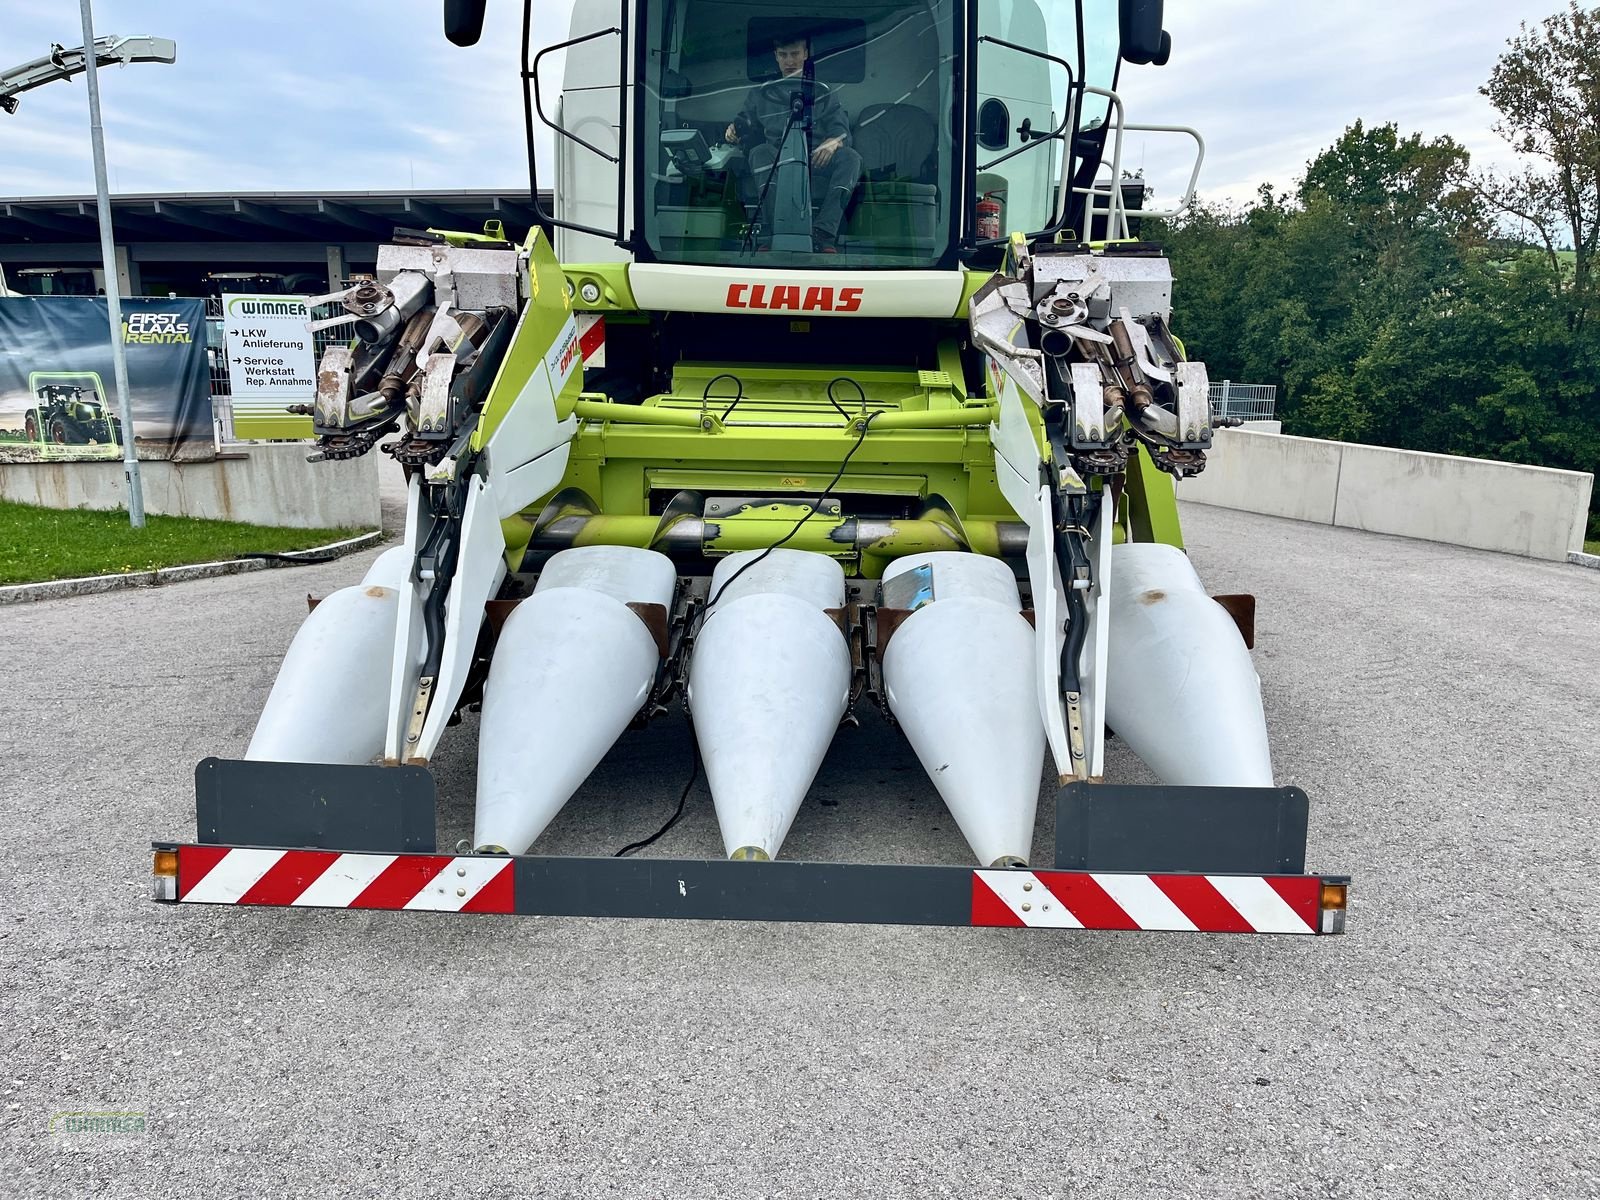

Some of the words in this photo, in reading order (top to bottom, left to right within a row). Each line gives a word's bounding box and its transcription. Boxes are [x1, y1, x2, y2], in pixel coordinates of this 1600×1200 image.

[726, 284, 864, 311] CLAAS
[241, 302, 307, 315] WIMMER
[128, 313, 180, 324] FIRST
[127, 323, 189, 334] CLAAS
[241, 328, 267, 338] LKW
[125, 333, 193, 344] RENTAL
[243, 339, 304, 351] Anlieferung
[244, 356, 284, 366] Service
[245, 367, 295, 376] Werkstatt
[246, 377, 267, 387] Rep.
[269, 378, 313, 386] Annahme
